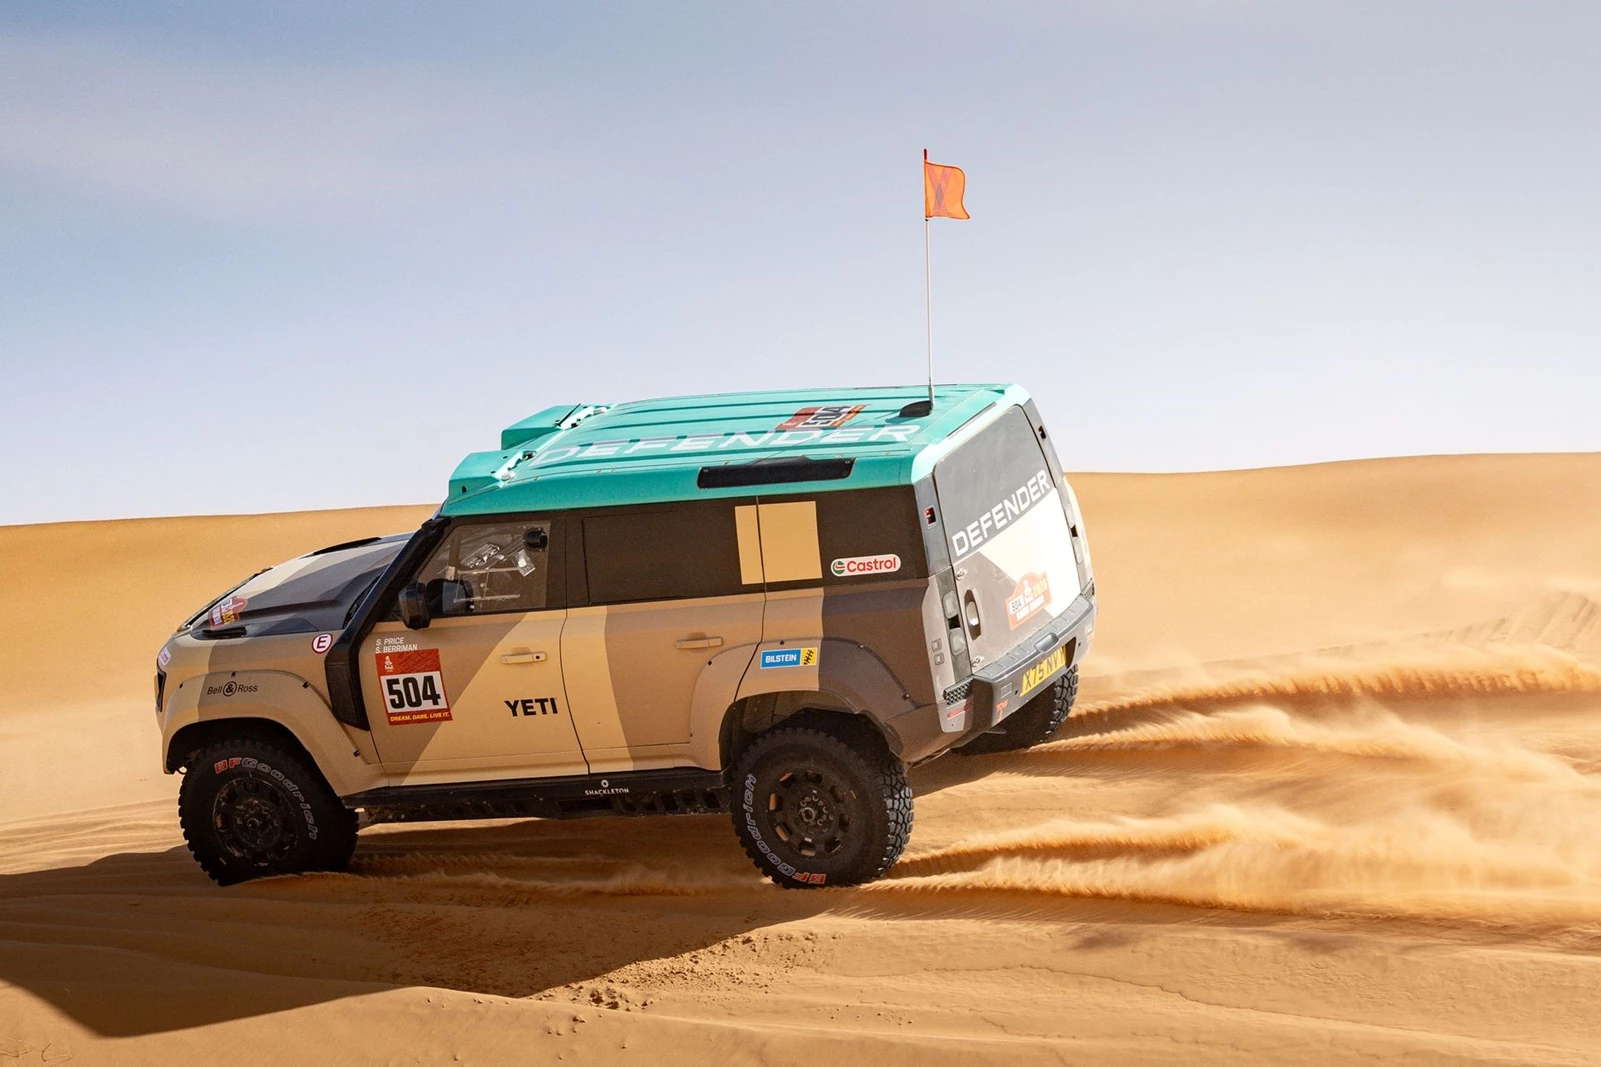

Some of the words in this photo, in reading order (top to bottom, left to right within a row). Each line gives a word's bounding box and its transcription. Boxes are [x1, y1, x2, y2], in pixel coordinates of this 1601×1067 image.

[528, 424, 921, 467] DEFENDER
[951, 469, 1051, 557] DEFENDER
[846, 557, 897, 573] Castrol
[316, 635, 328, 649] E
[375, 646, 382, 654] S.
[383, 644, 417, 652] BERRIMAN
[384, 637, 404, 645] PRICE
[765, 653, 797, 664] BILSTEIN
[207, 686, 222, 695] Bell
[237, 684, 258, 693] Ross
[386, 675, 441, 709] 504
[504, 697, 558, 717] YETI
[214, 757, 319, 840] BFGoodrich
[584, 788, 630, 796] SHACKLETON
[744, 774, 826, 885] BFGoodrich
